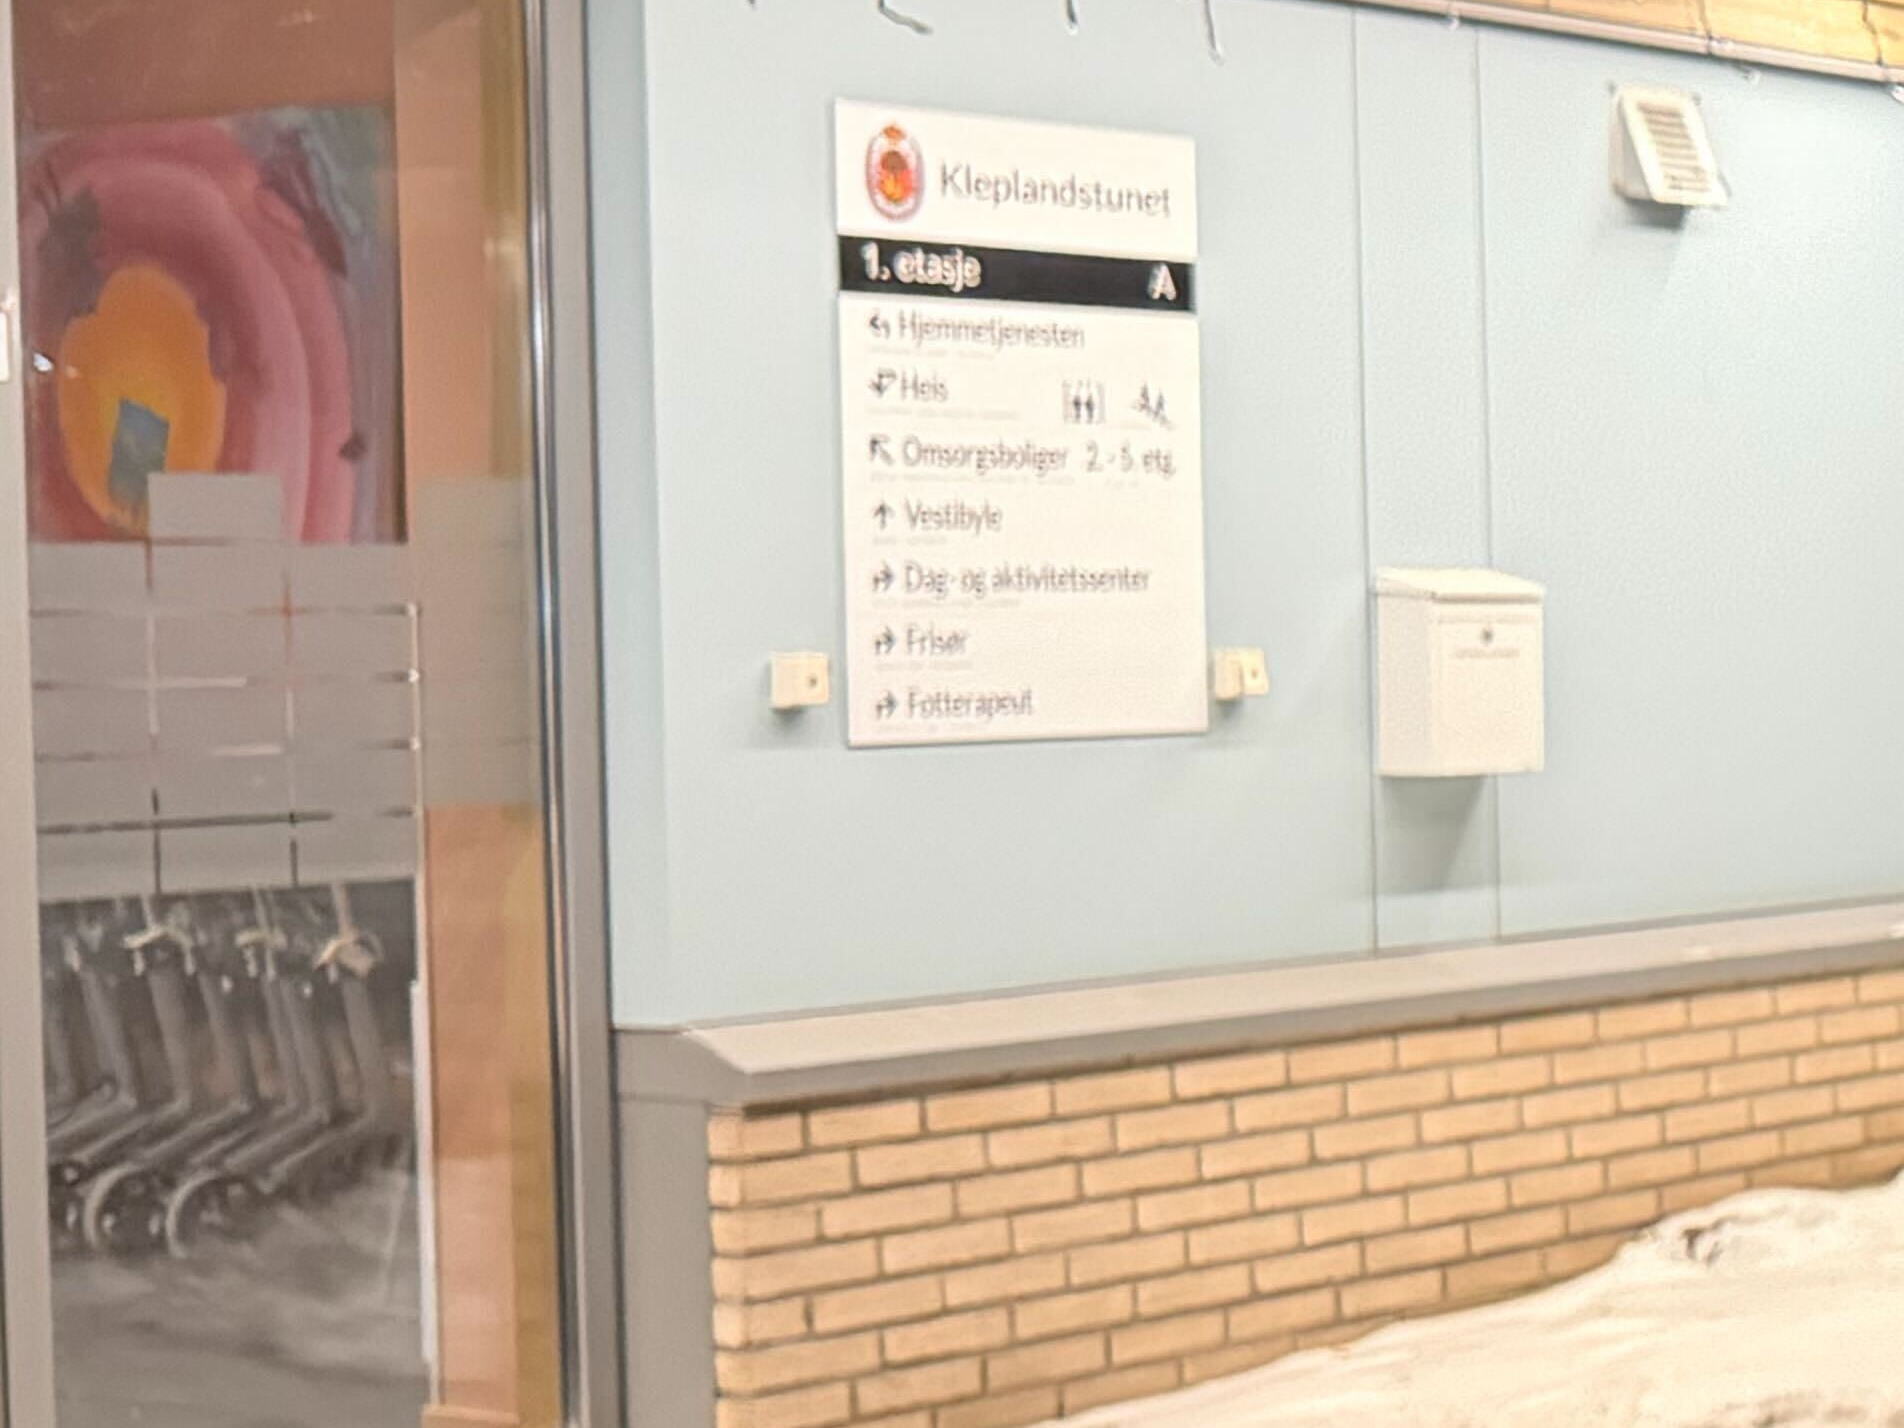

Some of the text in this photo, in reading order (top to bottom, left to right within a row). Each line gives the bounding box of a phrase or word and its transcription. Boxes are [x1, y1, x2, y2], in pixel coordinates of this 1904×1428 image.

[940, 162, 1171, 217] Kleplandstunet
[861, 241, 982, 293] 1. etasje
[1148, 261, 1179, 301] A
[899, 310, 1086, 351] Hjemmetjenesten
[901, 372, 948, 403] Heis
[902, 434, 1067, 476] Omsorgsboliger
[904, 498, 1003, 535] Vestibyle
[960, 568, 987, 599] og
[992, 560, 1151, 593] aktivitetssenter
[906, 624, 969, 656] Frisør
[907, 685, 1034, 720] Fotterapeut
